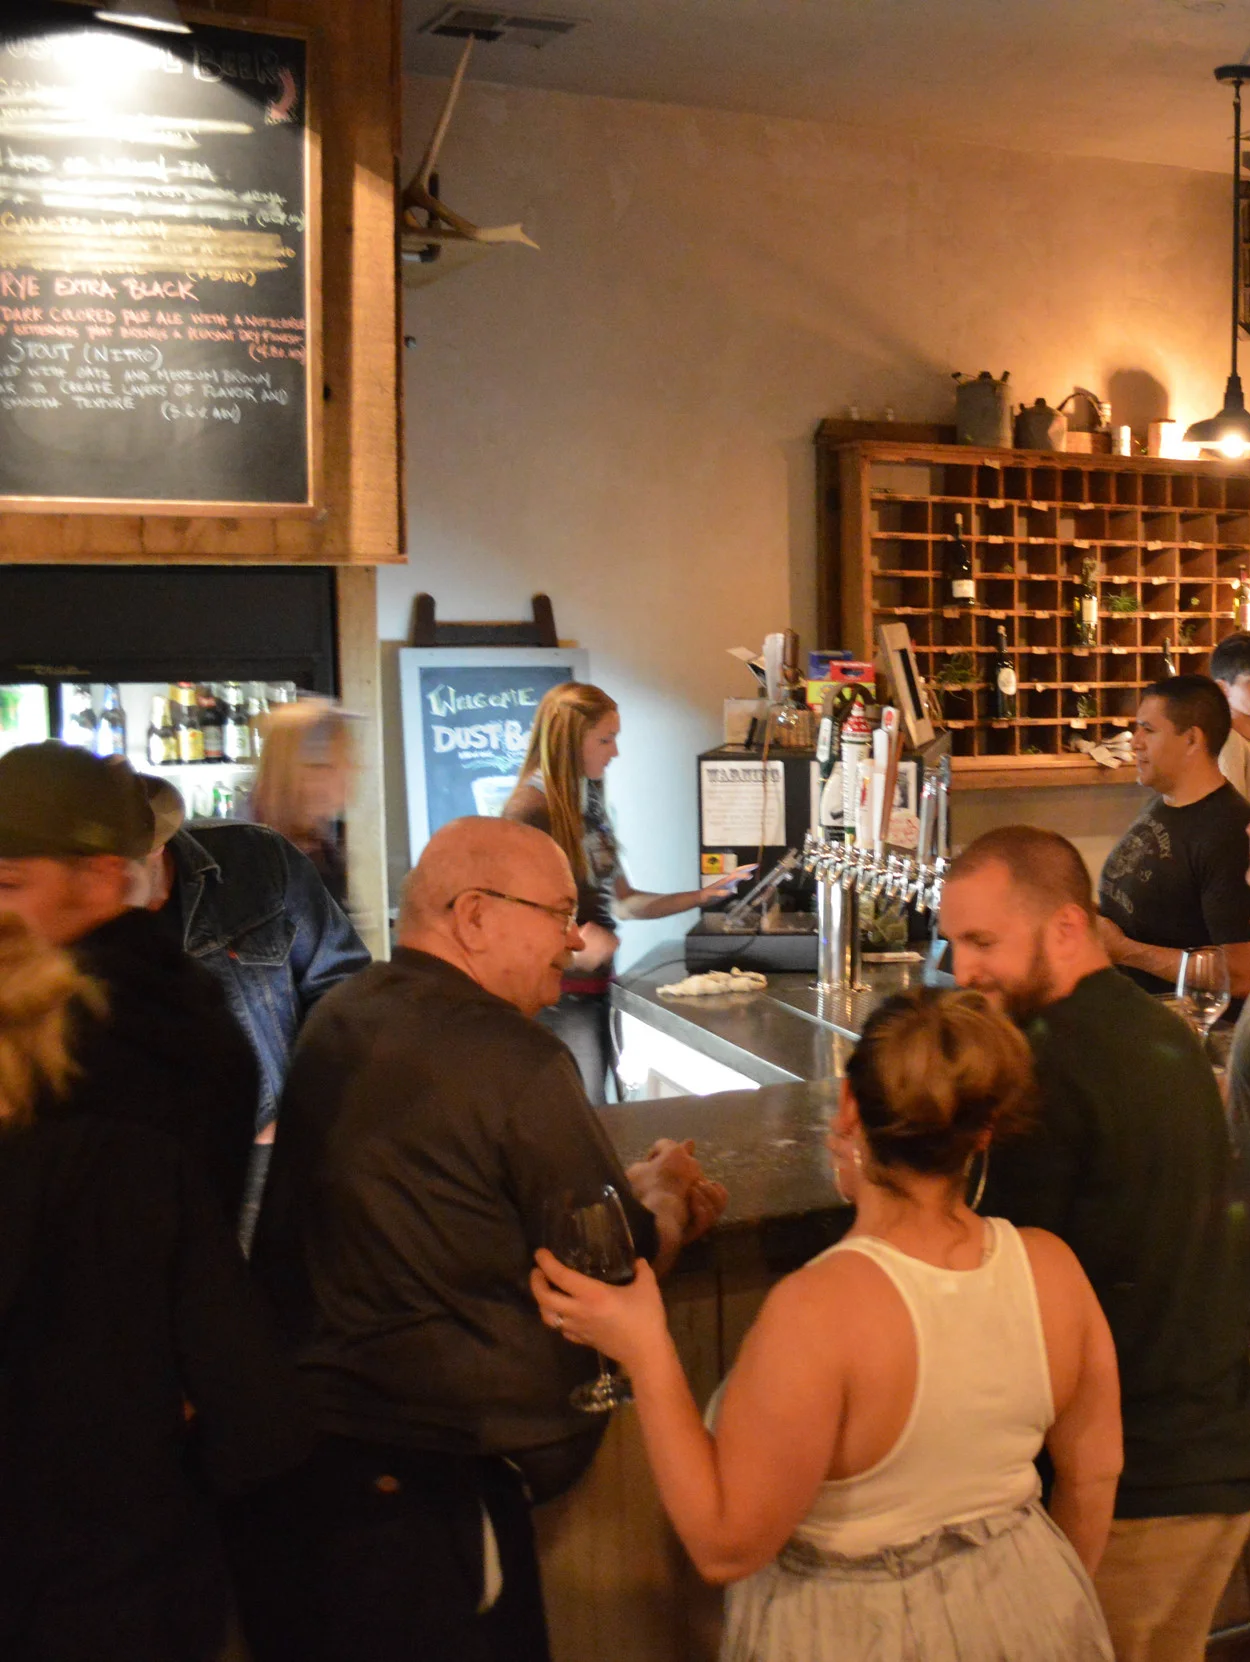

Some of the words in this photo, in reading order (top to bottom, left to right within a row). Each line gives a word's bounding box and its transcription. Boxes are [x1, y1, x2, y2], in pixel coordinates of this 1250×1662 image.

[1, 270, 41, 301] RYE
[54, 275, 118, 300] EXTRA
[121, 276, 199, 301] BLACK
[0, 304, 45, 322] DARK
[7, 337, 75, 363] STOUT
[425, 684, 539, 717] WELCOME
